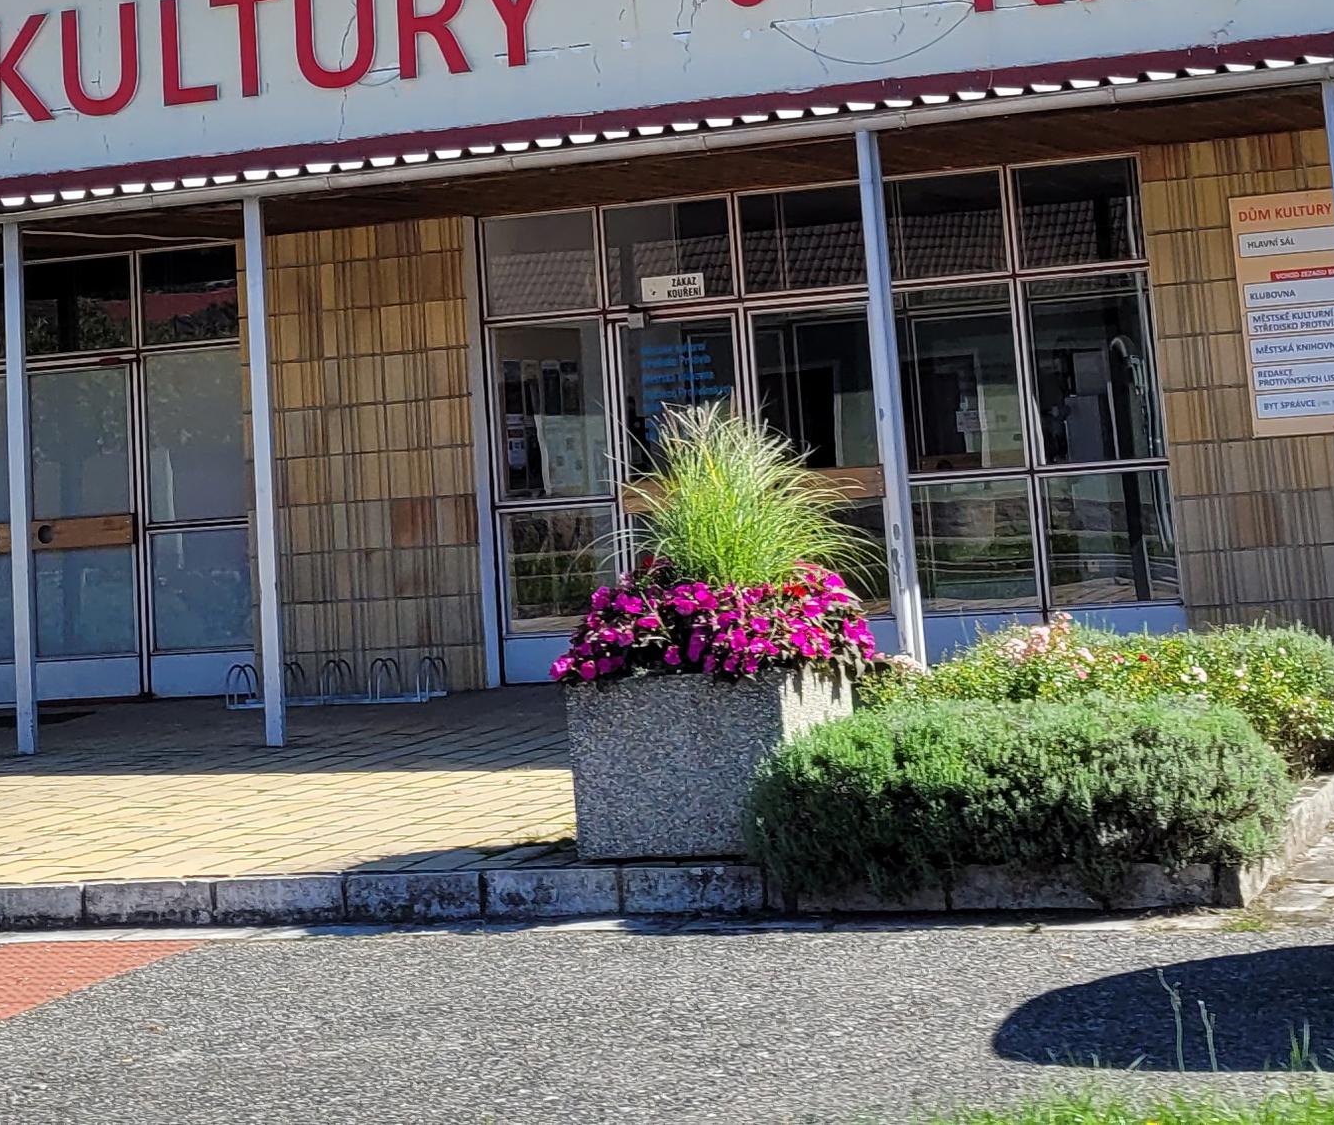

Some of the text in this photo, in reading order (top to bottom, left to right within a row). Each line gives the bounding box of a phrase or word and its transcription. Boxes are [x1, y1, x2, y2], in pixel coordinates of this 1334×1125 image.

[1238, 207, 1271, 222] DŮM
[1275, 203, 1332, 219] KULTURY
[1247, 236, 1295, 249] HLAVNÍ SÁL
[667, 277, 702, 298] ZÁKAZ KOUŘENÍ
[1249, 289, 1296, 300] KLUBOVNA
[1252, 307, 1334, 323] MĚSTSKÉ KULTURNÍ
[1253, 321, 1298, 333] STŘEDISKO
[1255, 343, 1295, 355] MĚSTSKÁ
[1257, 368, 1293, 378] REDAKCE
[1263, 402, 1278, 411] BYT
[1280, 399, 1316, 410] SPRÁVCE
